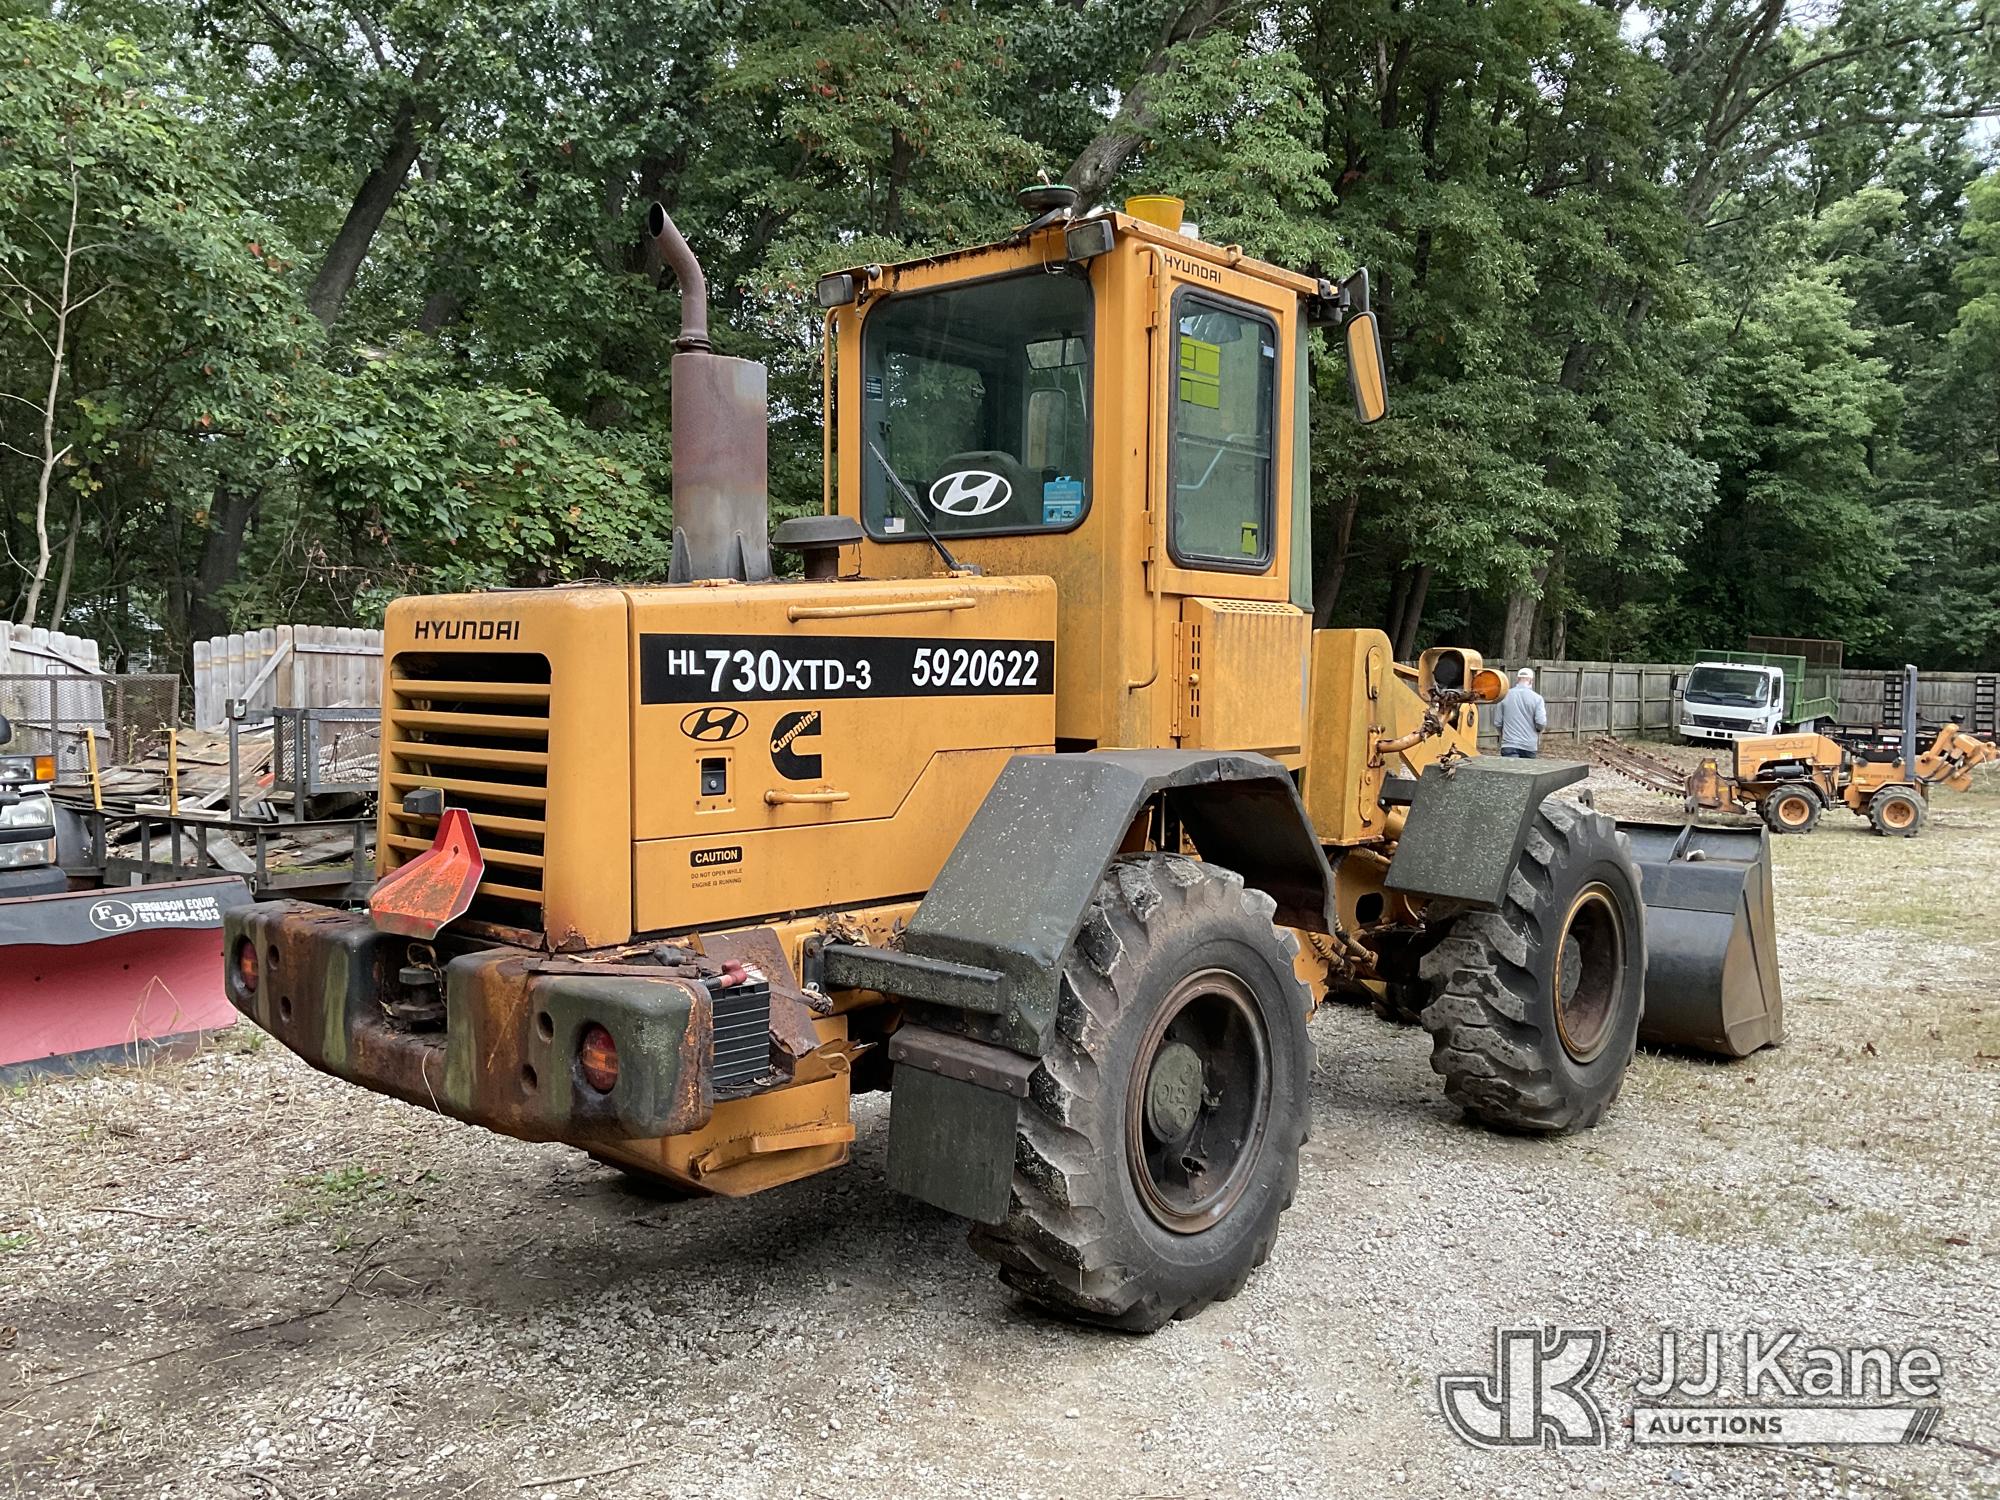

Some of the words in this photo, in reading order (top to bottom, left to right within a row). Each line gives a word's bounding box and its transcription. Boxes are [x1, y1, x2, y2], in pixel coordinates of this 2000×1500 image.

[1164, 253, 1221, 284] HYUNDAI
[414, 620, 520, 640] HYUNDAI
[911, 647, 1040, 687] 5920622
[770, 710, 819, 754] Cummins
[695, 849, 738, 863] CAUTION
[699, 871, 711, 879] NOT
[131, 900, 185, 912] FERGUSON
[185, 896, 219, 910] EQUIP.
[139, 908, 221, 923] 574-234-4303
